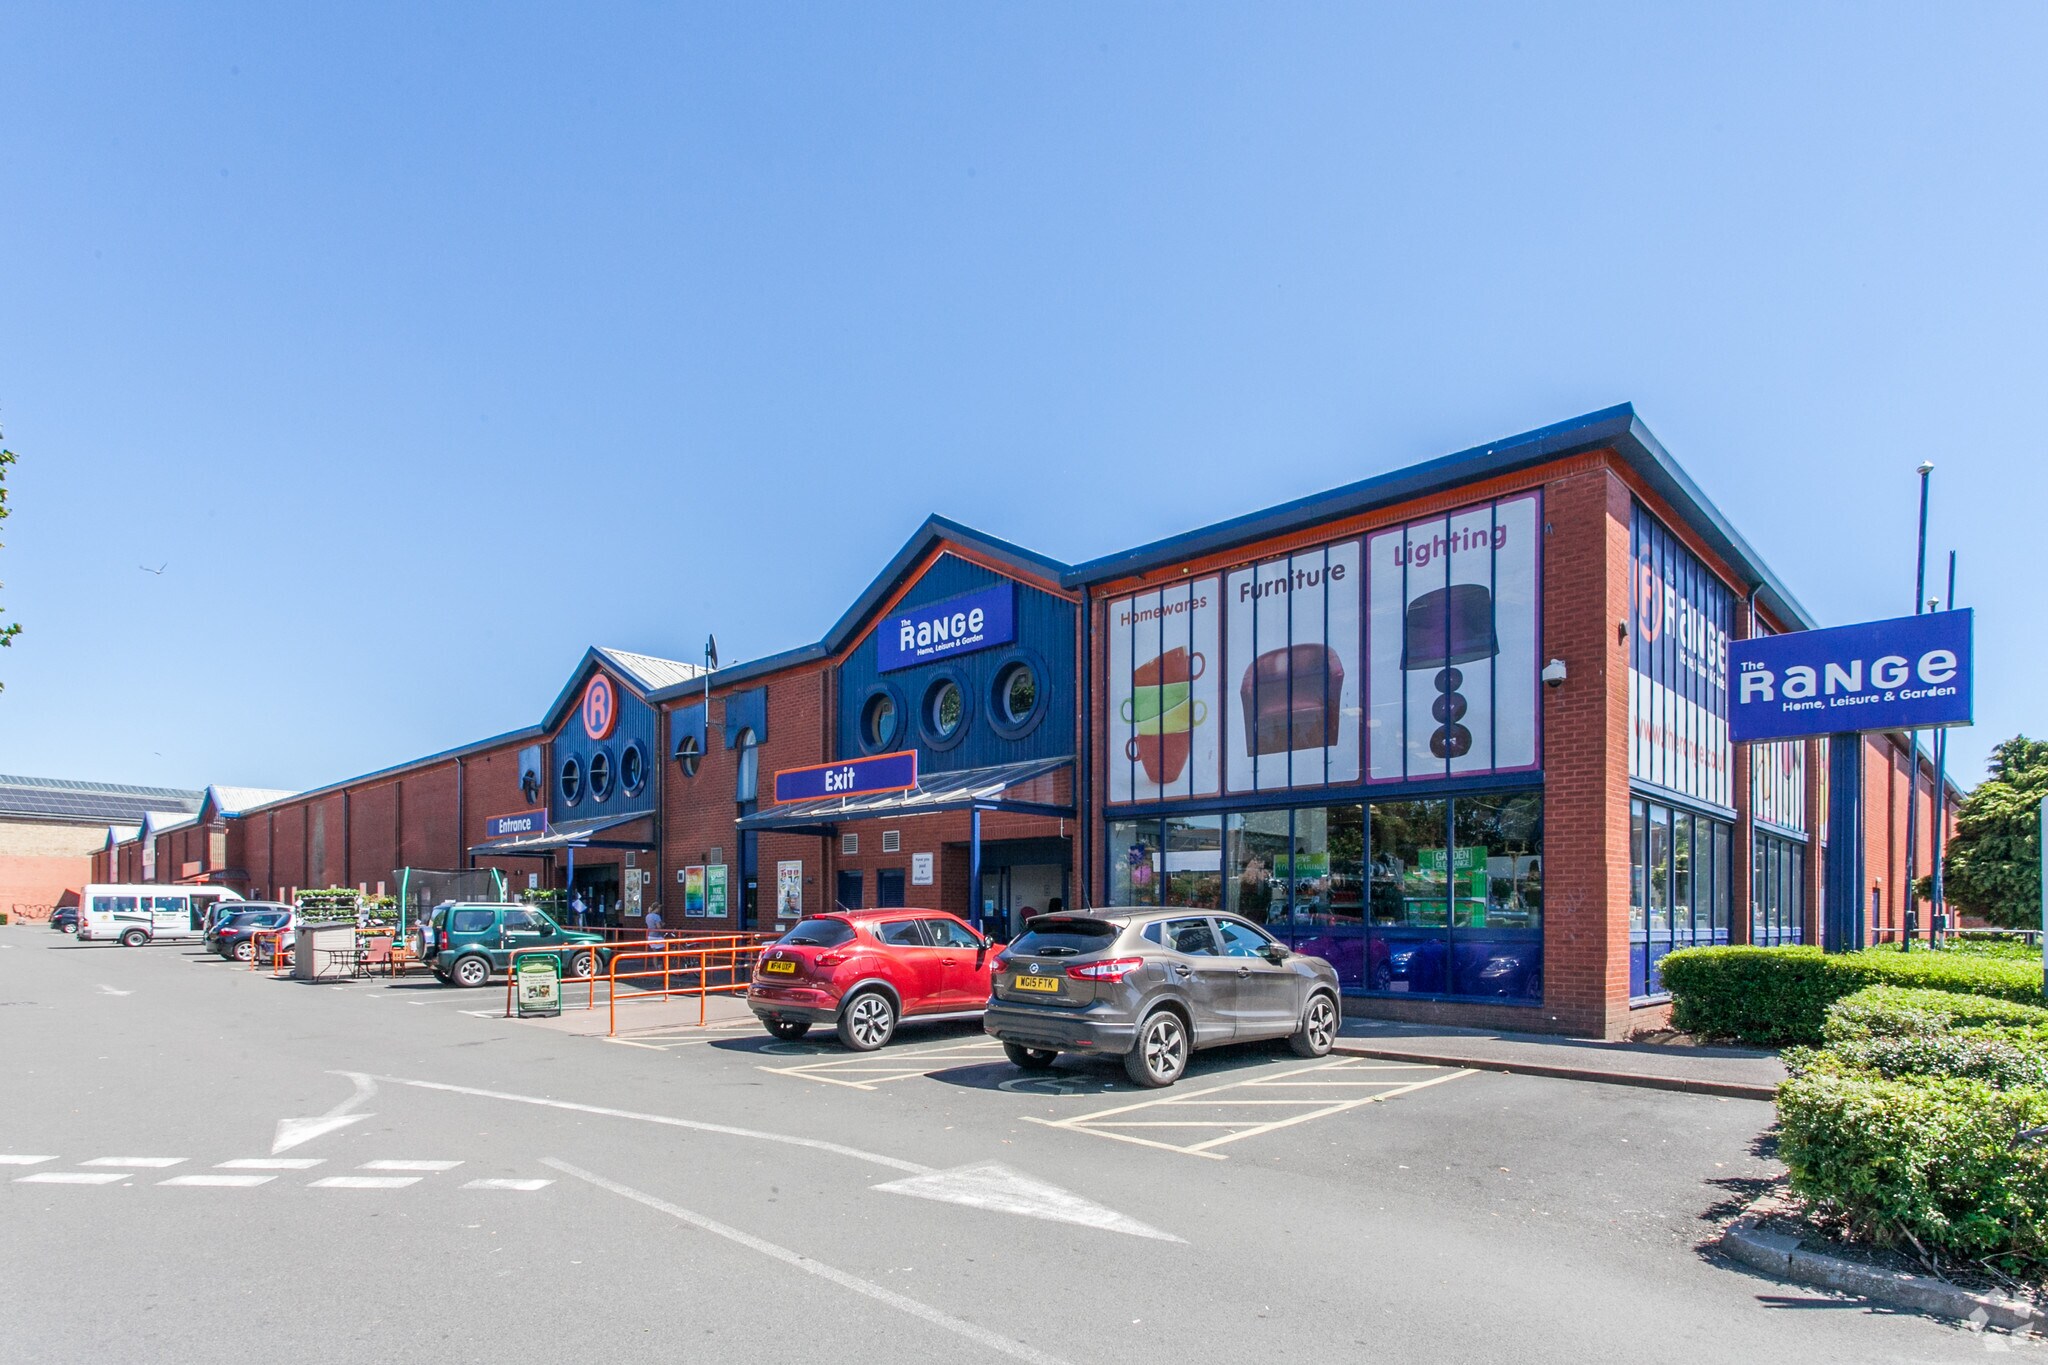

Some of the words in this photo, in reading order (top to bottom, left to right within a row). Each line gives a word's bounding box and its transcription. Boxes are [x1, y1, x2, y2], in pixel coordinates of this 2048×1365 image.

[1394, 524, 1507, 567] Lighting
[1240, 564, 1345, 603] Furniture
[1121, 596, 1207, 626] Homewares
[900, 619, 911, 628] The
[916, 646, 935, 656] Home,
[935, 640, 955, 651] Leisure
[955, 639, 961, 647] &
[961, 633, 984, 645] Garden
[1740, 661, 1765, 671] The
[590, 686, 605, 727] R
[1783, 700, 1825, 712] Home,
[1830, 693, 1880, 707] Leisure
[1884, 691, 1896, 701] &
[1900, 686, 1956, 700] Garden
[825, 766, 855, 791] Exit
[499, 818, 531, 834] Entrance
[1435, 850, 1469, 861] GADEN
[1020, 976, 1036, 987] WG15
[1038, 978, 1054, 989] FTK
